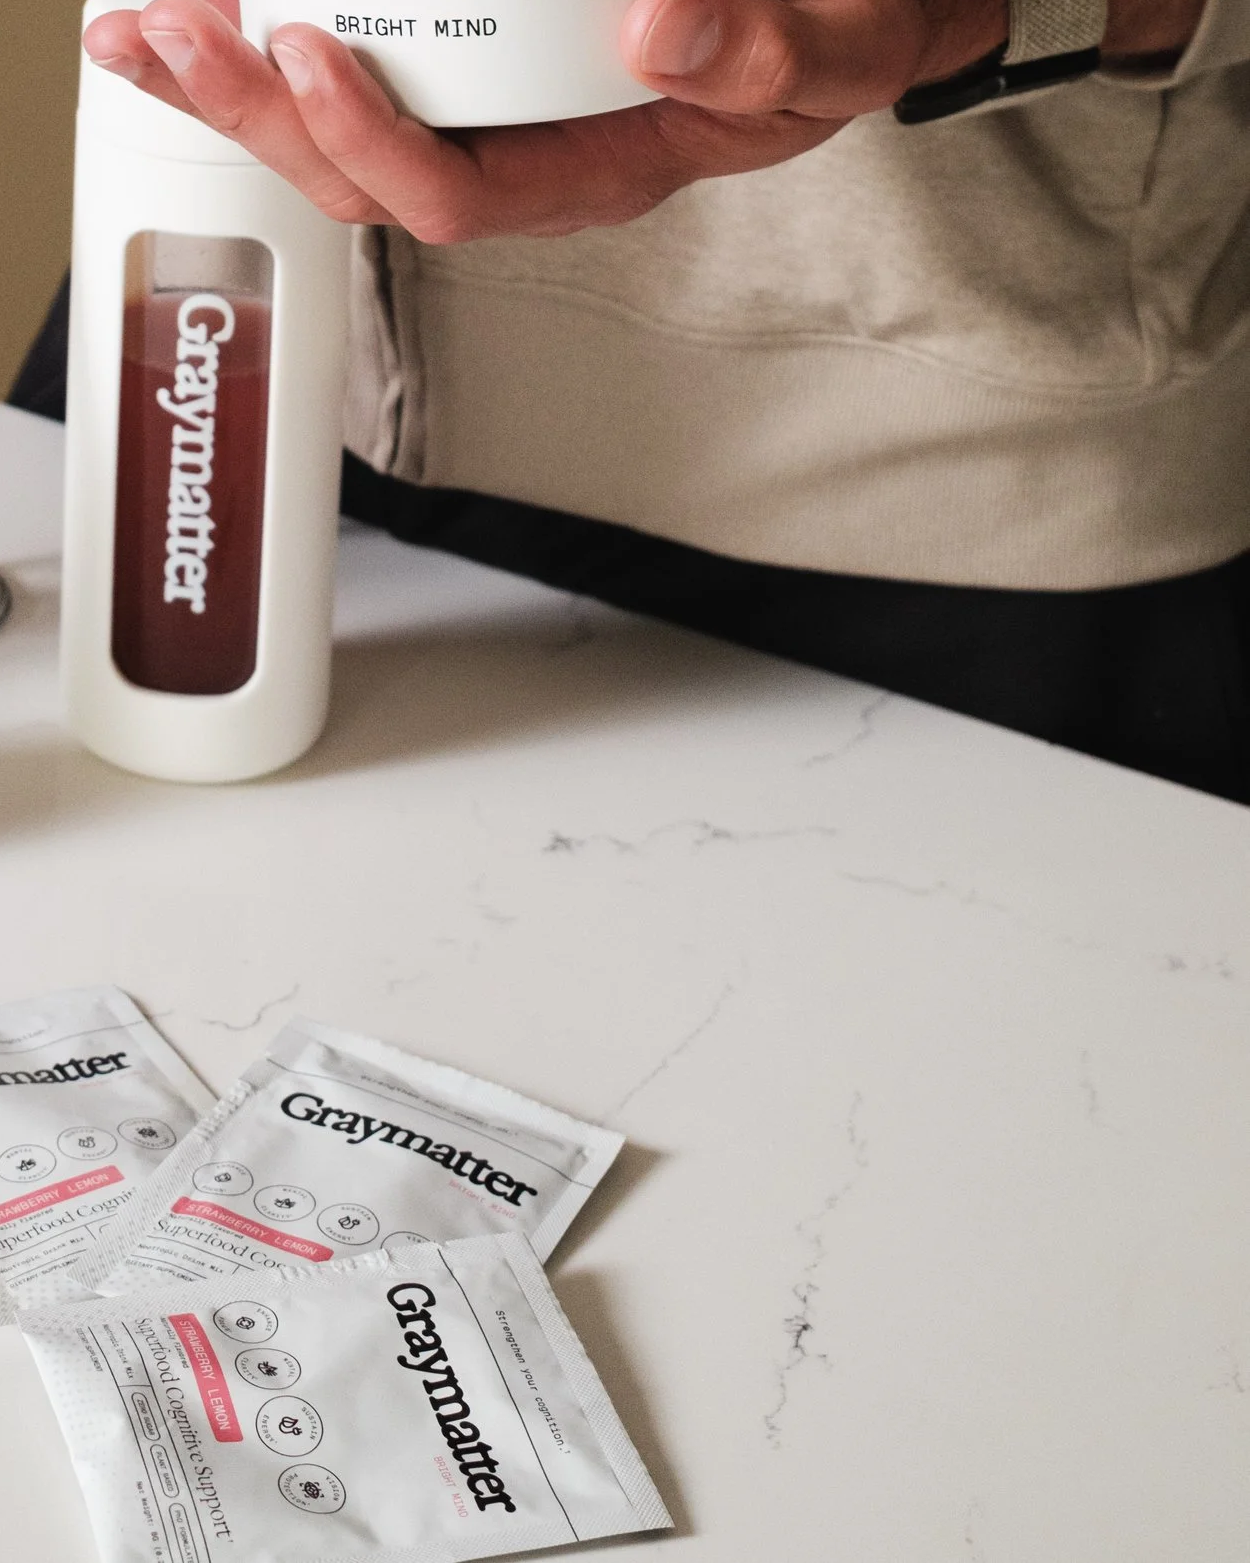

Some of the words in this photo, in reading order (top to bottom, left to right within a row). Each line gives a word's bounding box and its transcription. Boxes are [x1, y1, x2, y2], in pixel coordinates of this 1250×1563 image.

[335, 14, 417, 38] BRIGHT
[434, 17, 498, 38] MIND
[156, 292, 236, 615] Graymatter
[280, 1091, 539, 1208] Graymatter
[66, 1172, 111, 1195] LEMON
[153, 1218, 249, 1260] Superfood
[187, 1202, 269, 1240] STRAWBERRY
[275, 1235, 318, 1257] LEMON
[42, 1241, 67, 1256] Drink
[182, 1251, 207, 1267] Drink
[209, 1263, 225, 1275] Mix
[255, 1306, 273, 1333] ENHANCE
[174, 1341, 190, 1370] Flavored
[495, 1310, 526, 1365] Strengthen
[521, 1367, 540, 1392] your
[124, 1365, 135, 1380] Mix
[178, 1319, 217, 1380] STRAWBERRY
[207, 1388, 231, 1432] LEMON
[282, 1356, 296, 1379] MENTAL
[134, 1317, 181, 1384] Superfood
[165, 1387, 204, 1463] Cognitive
[386, 1282, 517, 1513] Graymatter
[300, 1405, 318, 1441] SUSTAIN
[155, 1450, 168, 1471] PLANT
[135, 1480, 146, 1494] Net
[324, 1475, 341, 1503] VISION
[433, 1455, 457, 1488] BRIGHT
[452, 1492, 470, 1519] MIND
